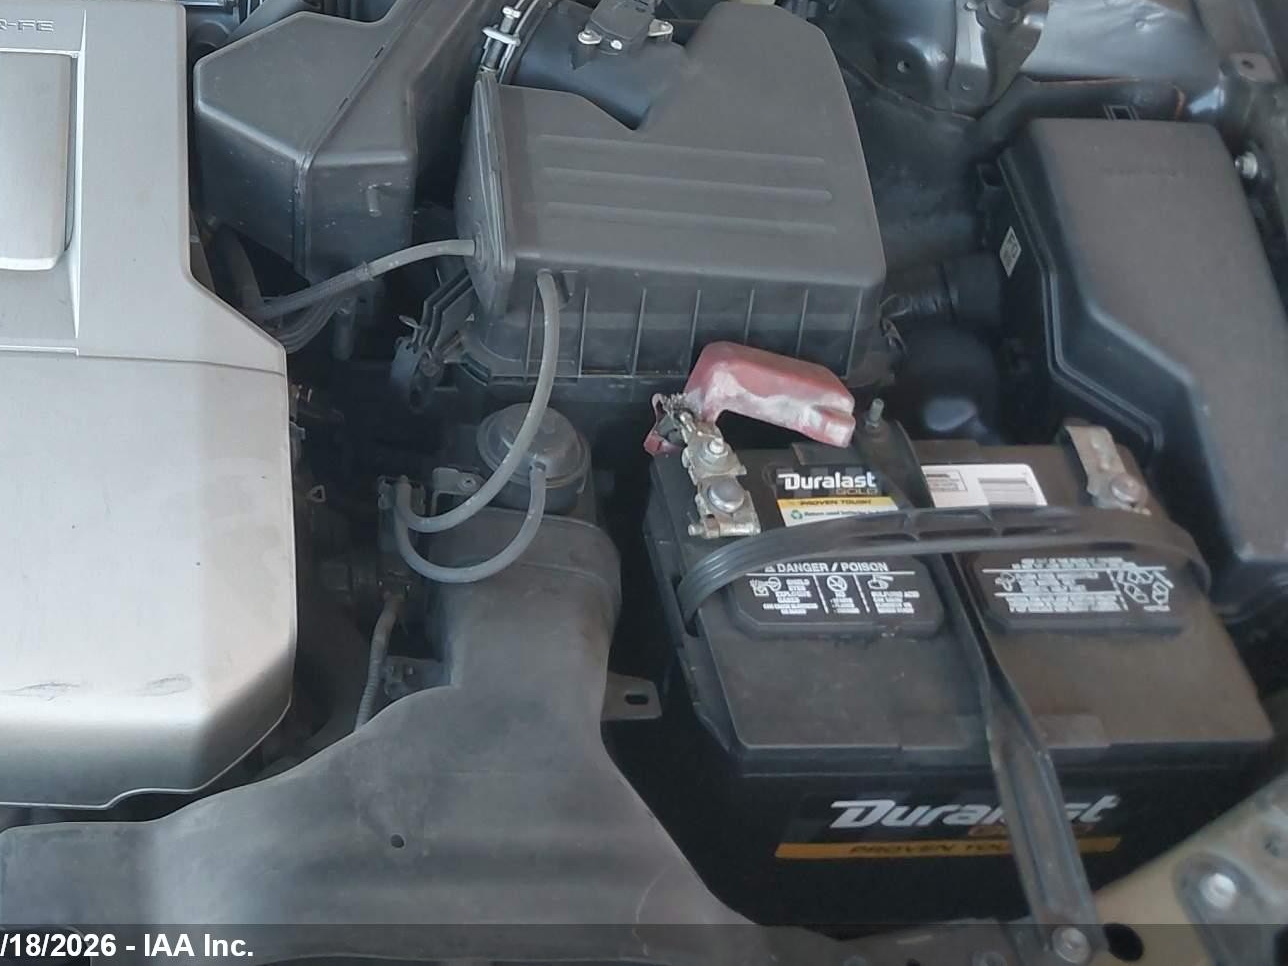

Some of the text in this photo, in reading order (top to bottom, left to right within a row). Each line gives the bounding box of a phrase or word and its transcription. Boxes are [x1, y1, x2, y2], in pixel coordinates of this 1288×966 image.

[777, 471, 877, 490] Duralast
[777, 562, 829, 573] DANGER
[841, 561, 889, 572] POISON
[830, 795, 1121, 828] Duralst
